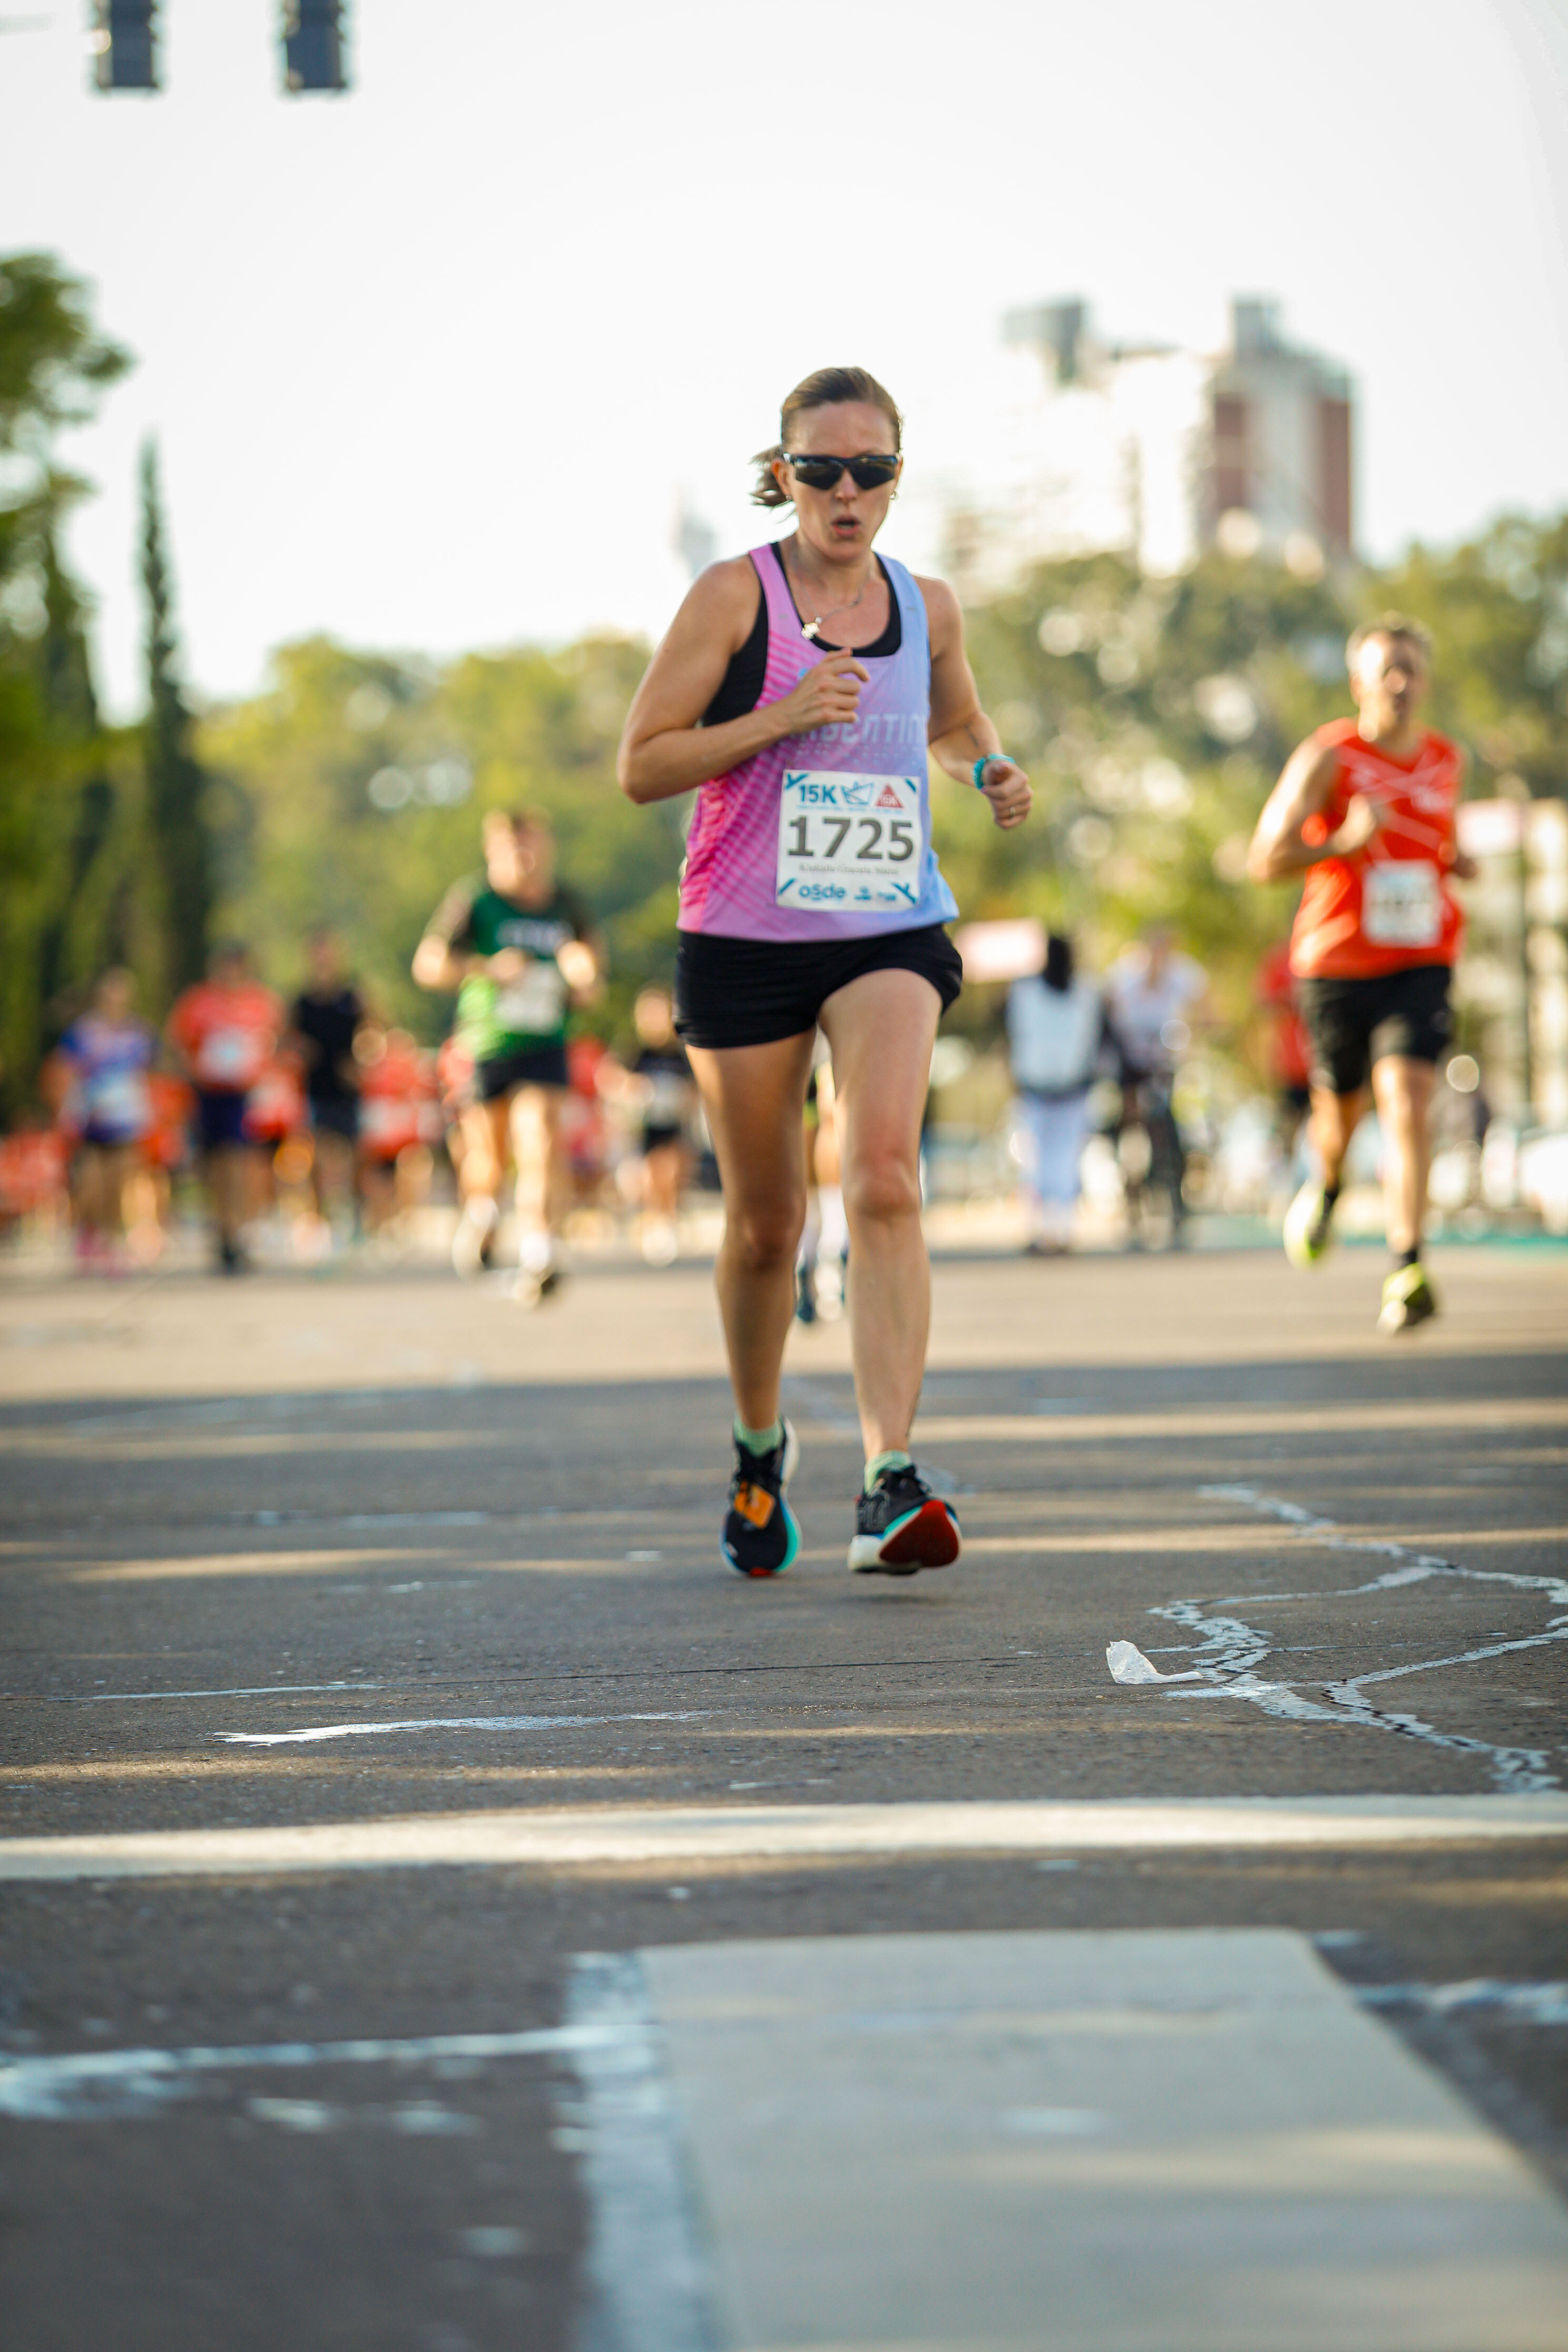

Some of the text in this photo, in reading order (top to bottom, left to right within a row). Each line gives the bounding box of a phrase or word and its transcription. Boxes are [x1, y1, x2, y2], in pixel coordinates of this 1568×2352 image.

[798, 783, 838, 805] 15K
[787, 815, 915, 861] 1725
[798, 883, 847, 899] osde
